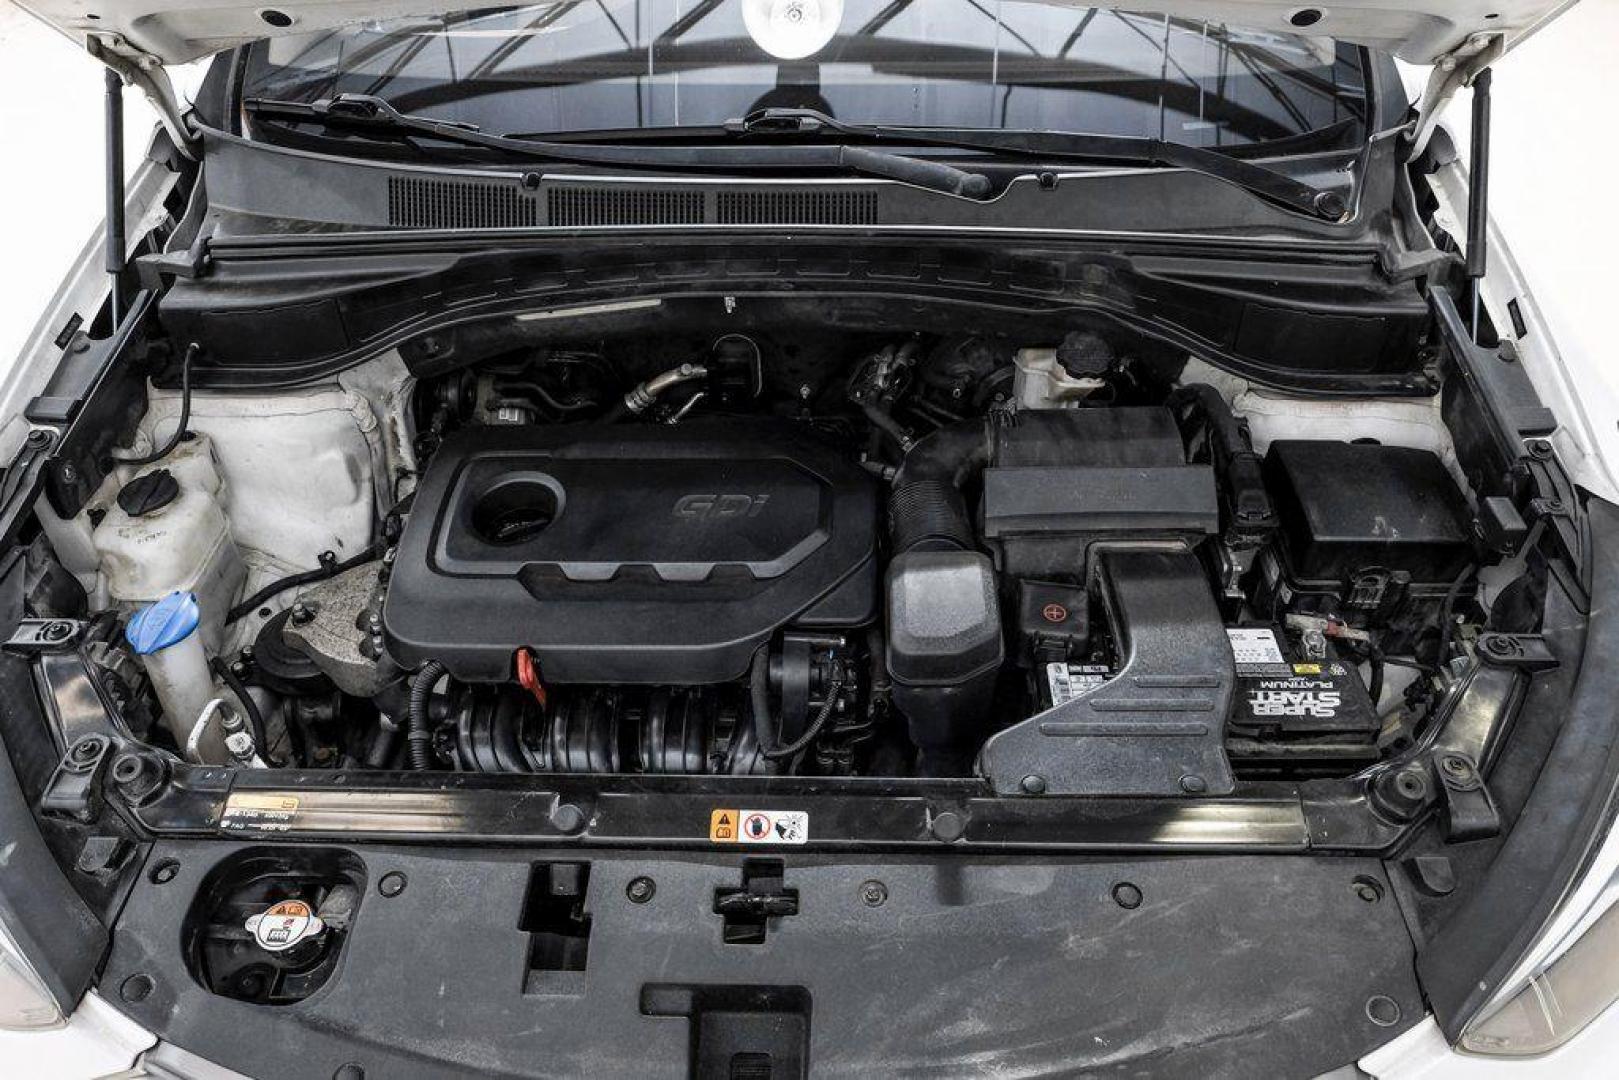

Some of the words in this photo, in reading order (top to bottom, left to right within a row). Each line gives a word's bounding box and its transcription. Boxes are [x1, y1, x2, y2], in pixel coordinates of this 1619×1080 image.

[1261, 681, 1334, 689] PLATINUM
[1249, 690, 1341, 707] START
[1253, 701, 1336, 717] SUPER
